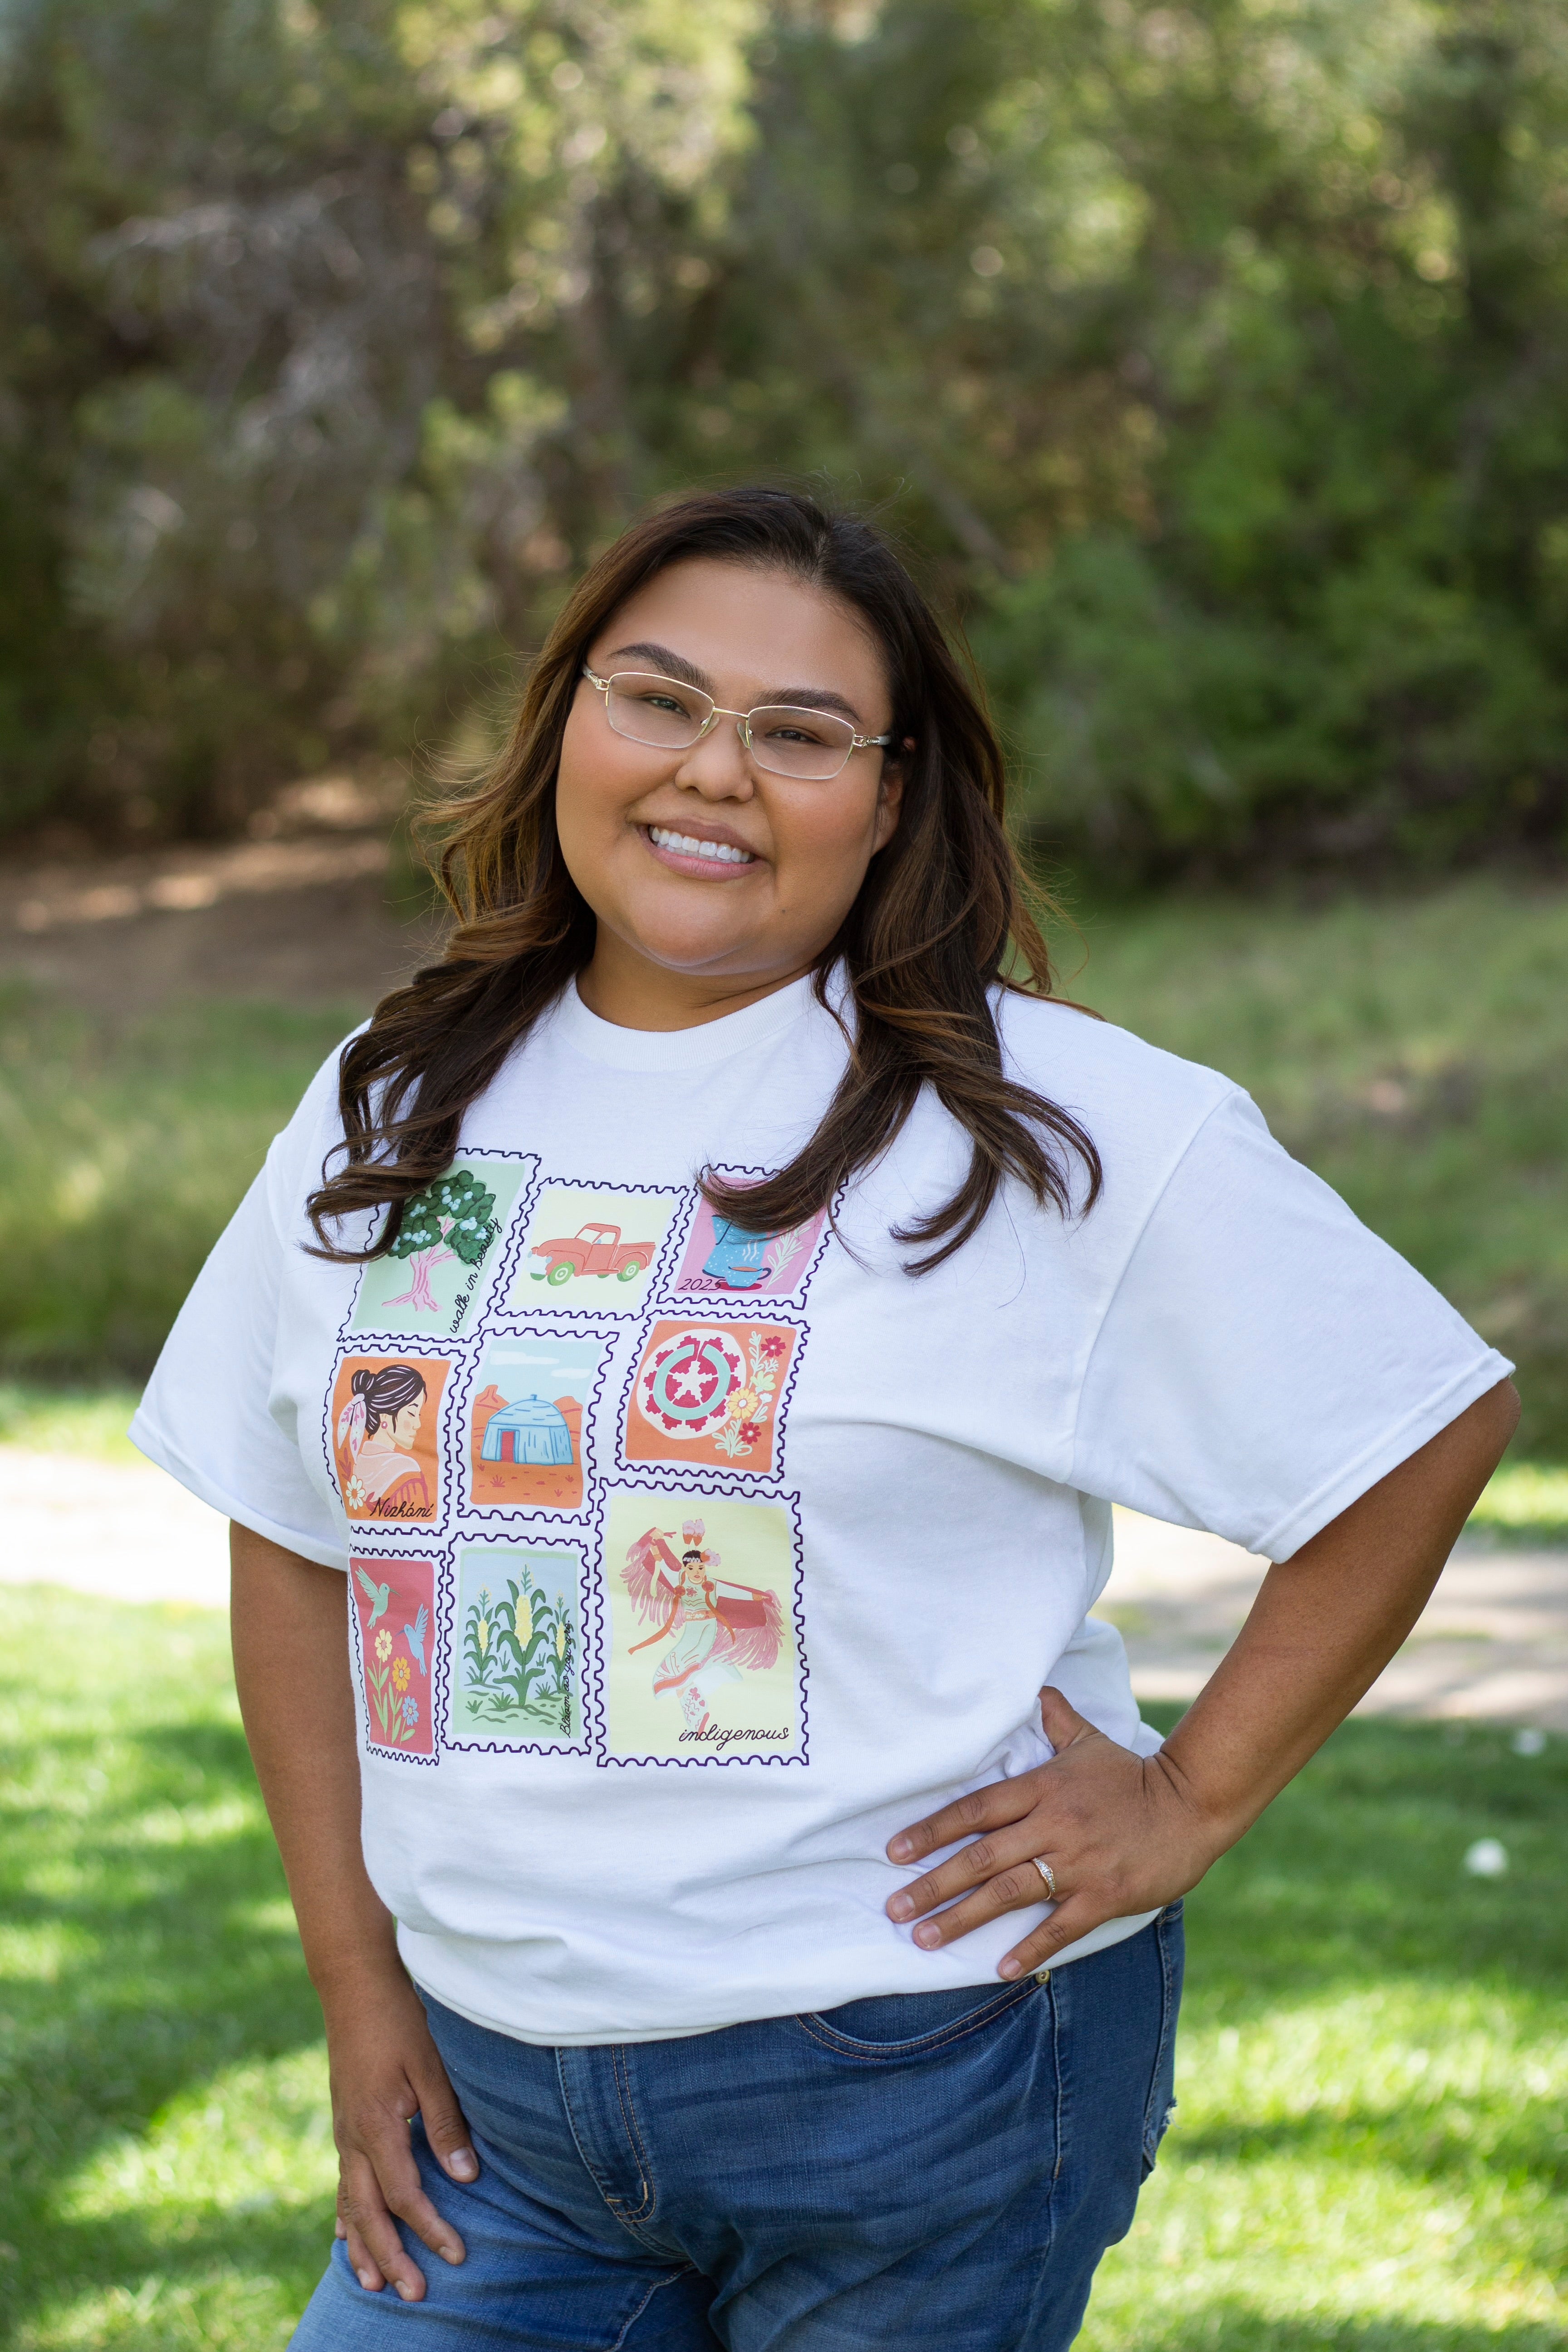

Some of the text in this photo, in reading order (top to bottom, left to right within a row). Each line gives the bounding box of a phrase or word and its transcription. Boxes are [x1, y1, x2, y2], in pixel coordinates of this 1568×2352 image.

[678, 1278, 727, 1291] 2025
[450, 1294, 470, 1333] walk
[465, 1273, 478, 1290] in
[369, 1497, 434, 1518] Nizhóní
[564, 1648, 575, 1676] you
[563, 1675, 569, 1692] as
[559, 1695, 571, 1739] Bloom
[679, 1724, 789, 1751] indigenous
